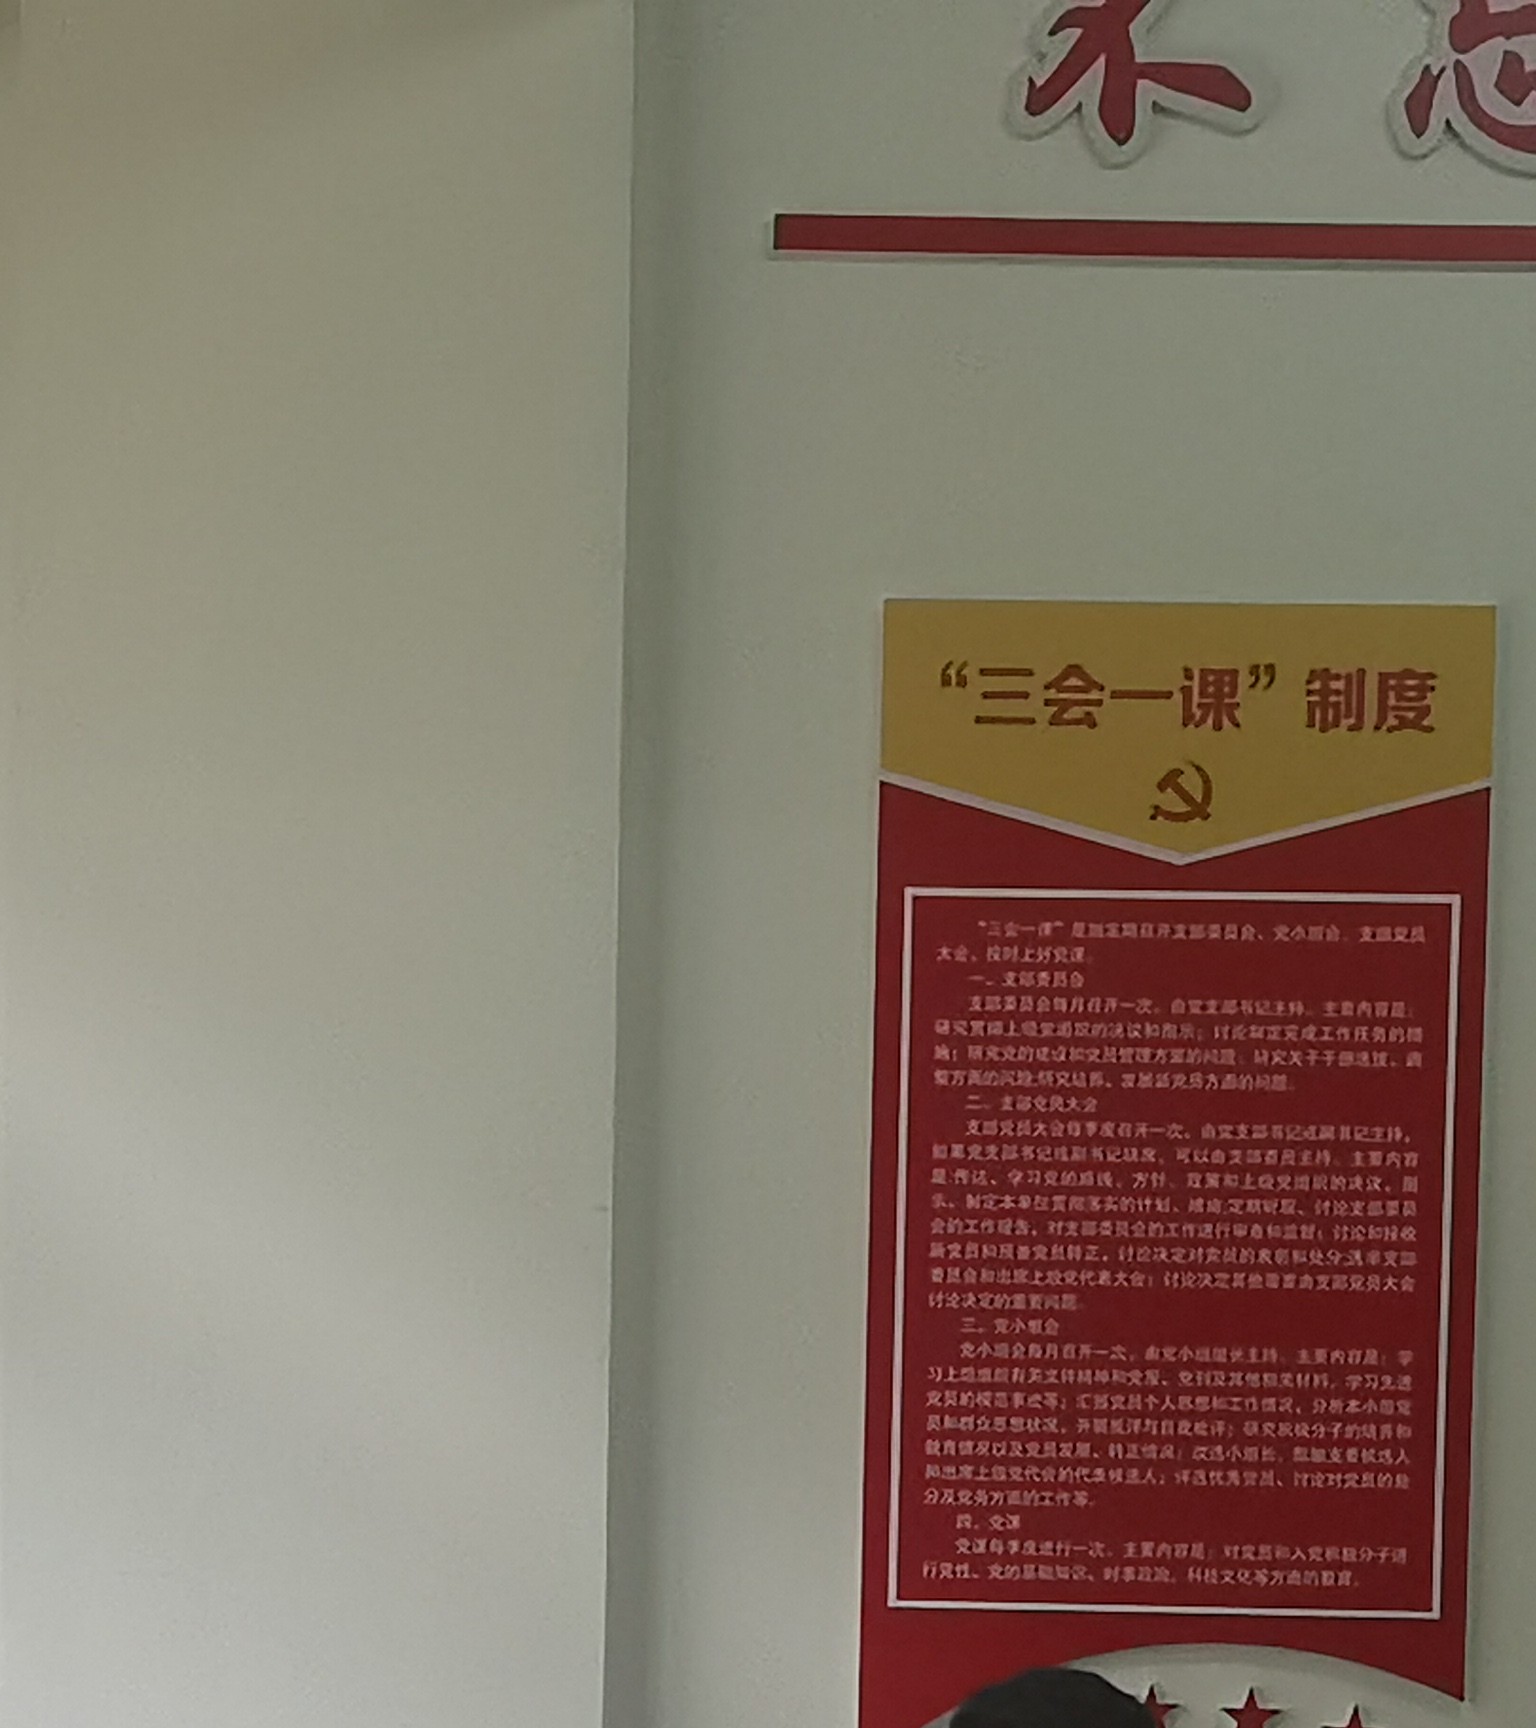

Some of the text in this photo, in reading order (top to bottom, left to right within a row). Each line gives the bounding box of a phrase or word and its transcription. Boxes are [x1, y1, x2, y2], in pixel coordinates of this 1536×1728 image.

[939, 659, 1438, 734] “三会一课”制度
